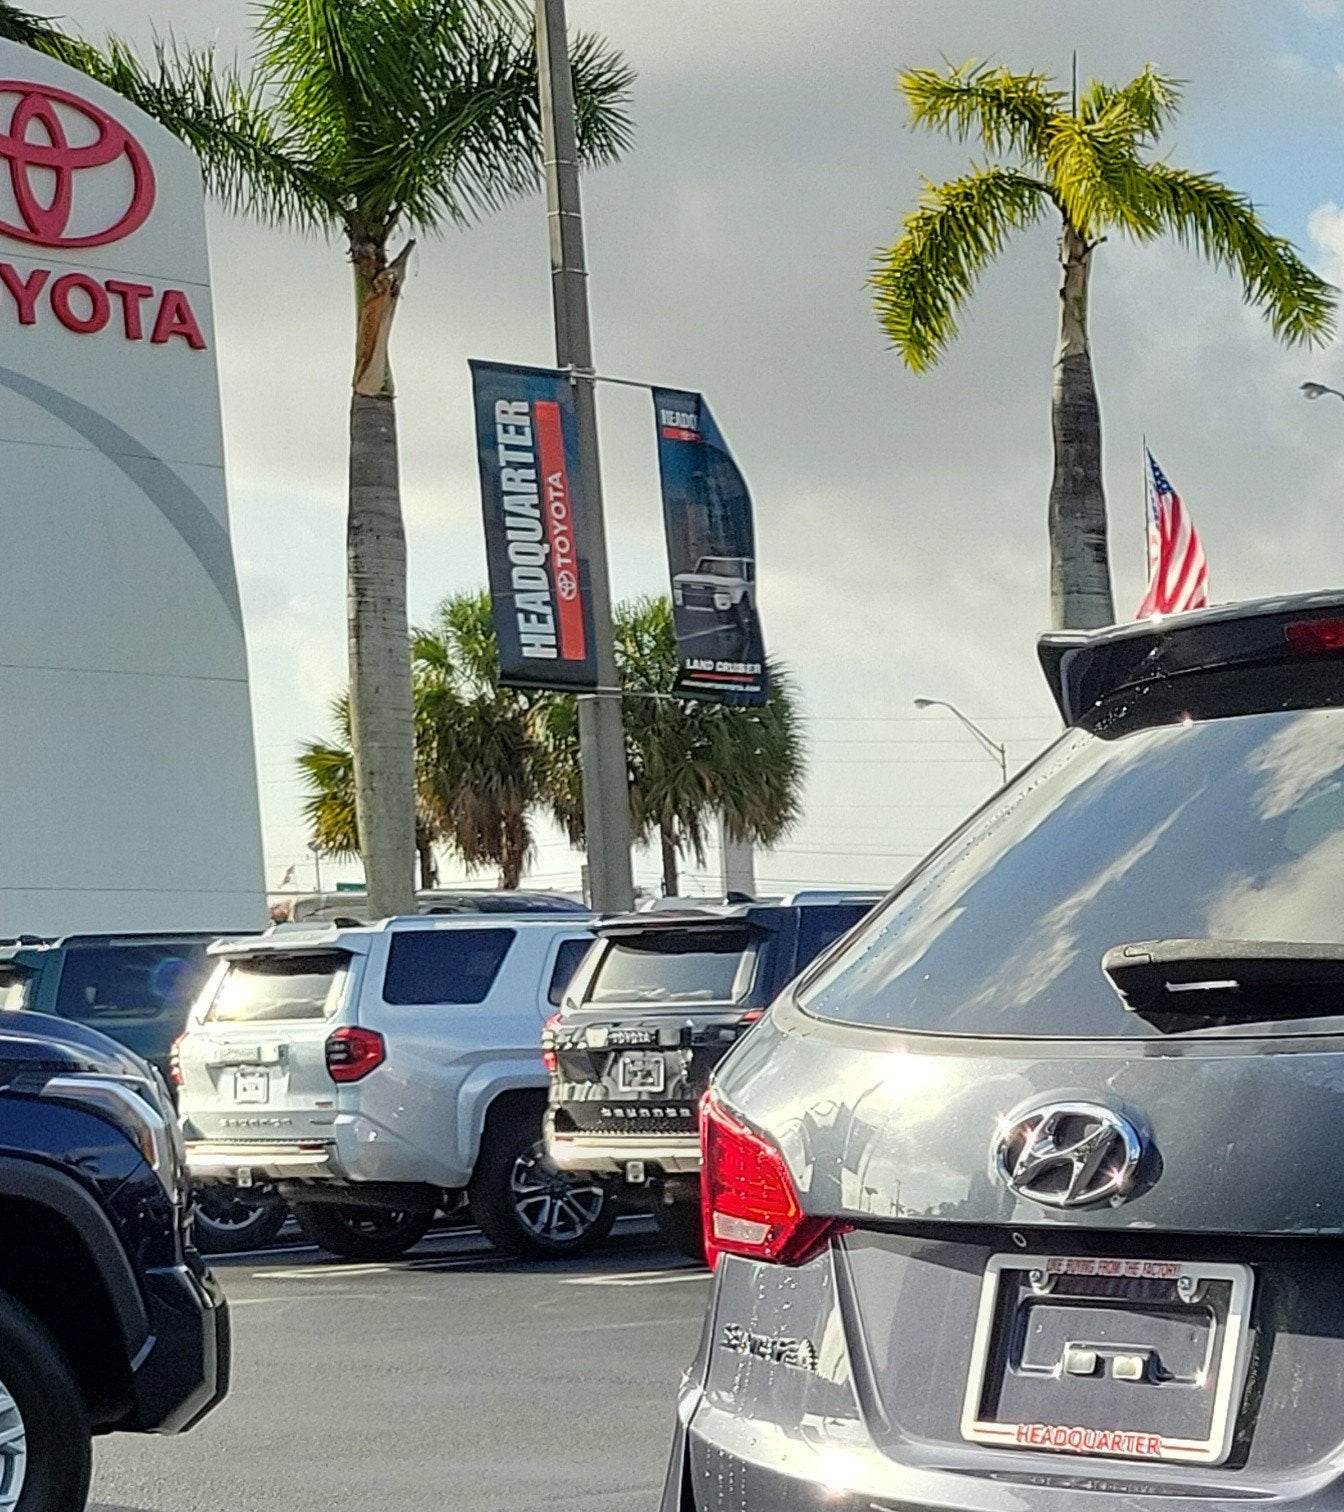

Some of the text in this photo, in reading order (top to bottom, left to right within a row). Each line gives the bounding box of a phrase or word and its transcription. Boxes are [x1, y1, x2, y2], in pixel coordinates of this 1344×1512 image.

[0, 262, 207, 350] YOTA
[496, 399, 559, 659] HEADQUARTER
[547, 472, 574, 568] TOYOTA
[685, 657, 714, 671] LAND
[1016, 1424, 1162, 1456] HEADQUARTER
